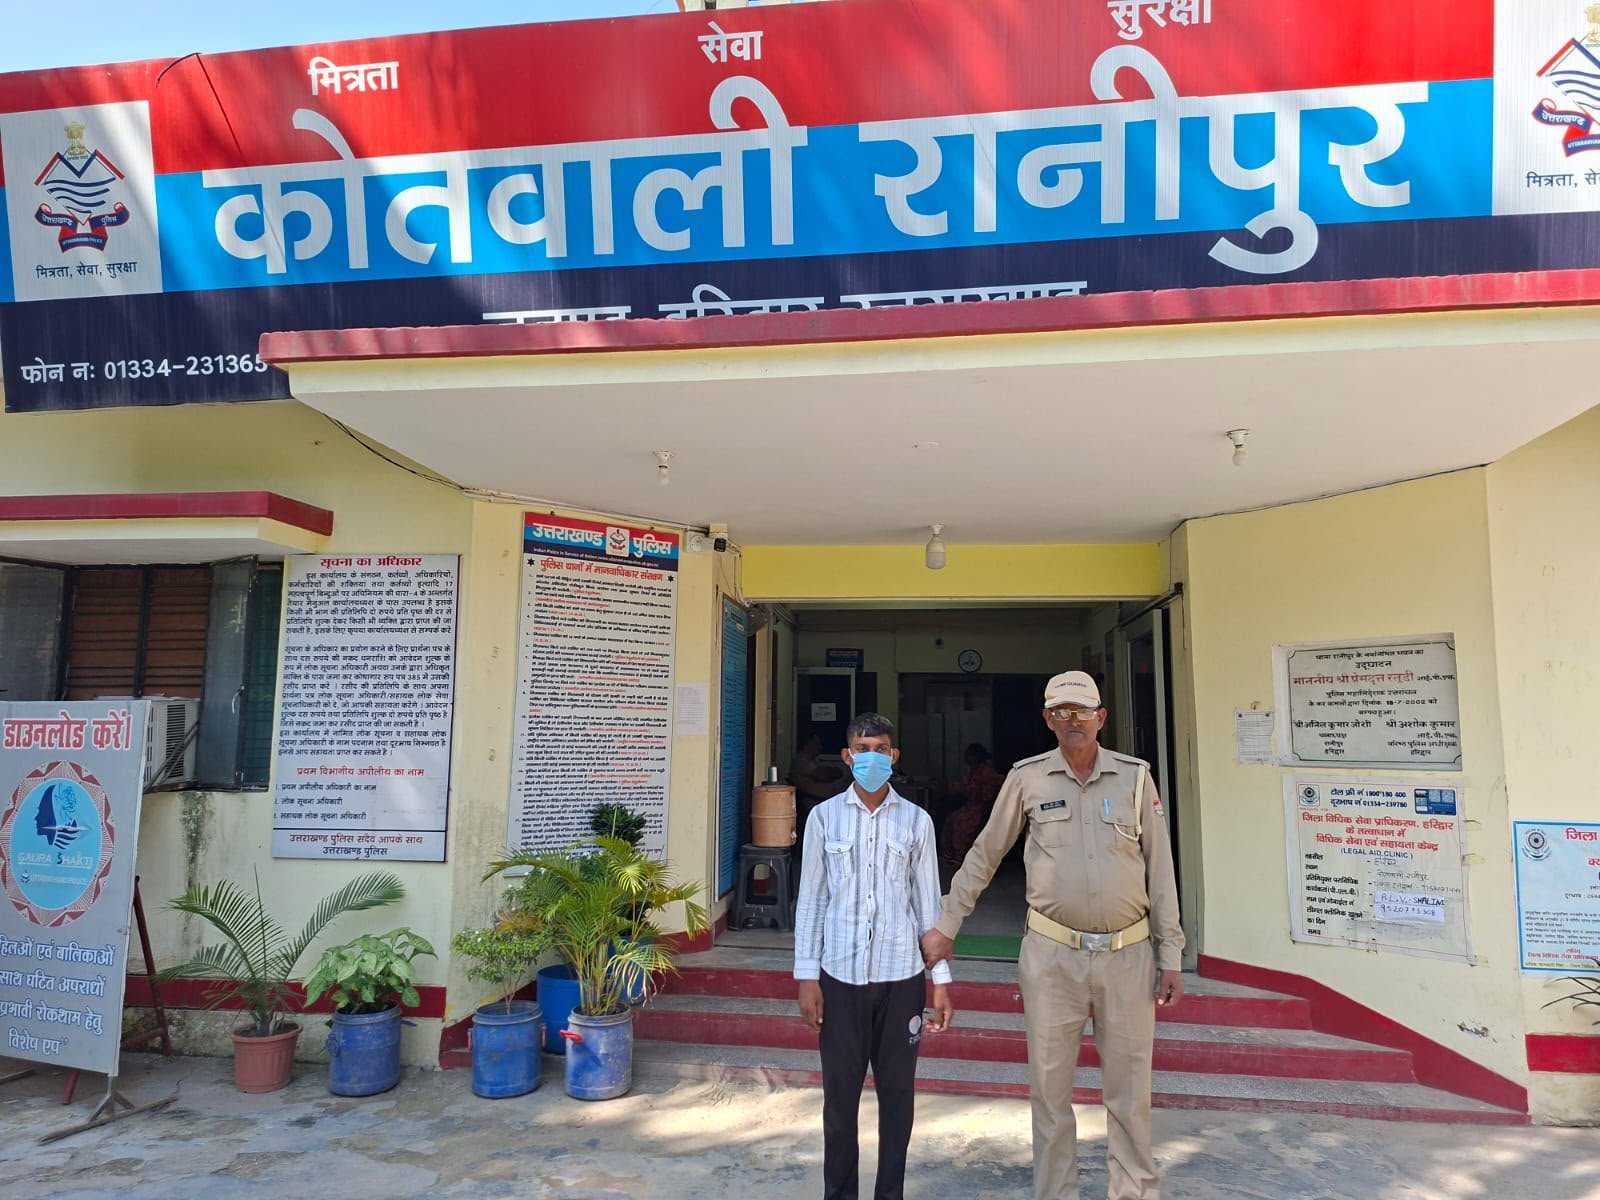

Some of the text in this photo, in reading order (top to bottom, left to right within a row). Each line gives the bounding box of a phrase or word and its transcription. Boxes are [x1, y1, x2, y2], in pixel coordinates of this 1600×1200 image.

[699, 21, 763, 64] सेवा
[309, 56, 399, 96] मित्रता
[202, 45, 1428, 275] कोतवाली रानीपुर
[106, 261, 137, 278] सुरक्षा
[21, 357, 64, 383] फोन
[533, 523, 672, 558] उत्तराखण्ड पुलिस
[321, 556, 422, 569] सूचना का अधिकार
[540, 558, 563, 571] पुलिस
[4, 712, 86, 748] डाउनलोड
[1303, 813, 1323, 822] जिला
[1326, 814, 1352, 824] विधिक
[1356, 815, 1372, 825] सेवा
[1423, 819, 1454, 830] हरिद्वार
[290, 834, 328, 843] उत्तराखण्ड
[331, 833, 354, 845] पुलिस
[1316, 833, 1342, 843] विधिक
[1346, 835, 1362, 845] सेवा
[1566, 828, 1597, 841] जिला
[323, 846, 388, 858] उत्तराखण्ड पुलिस
